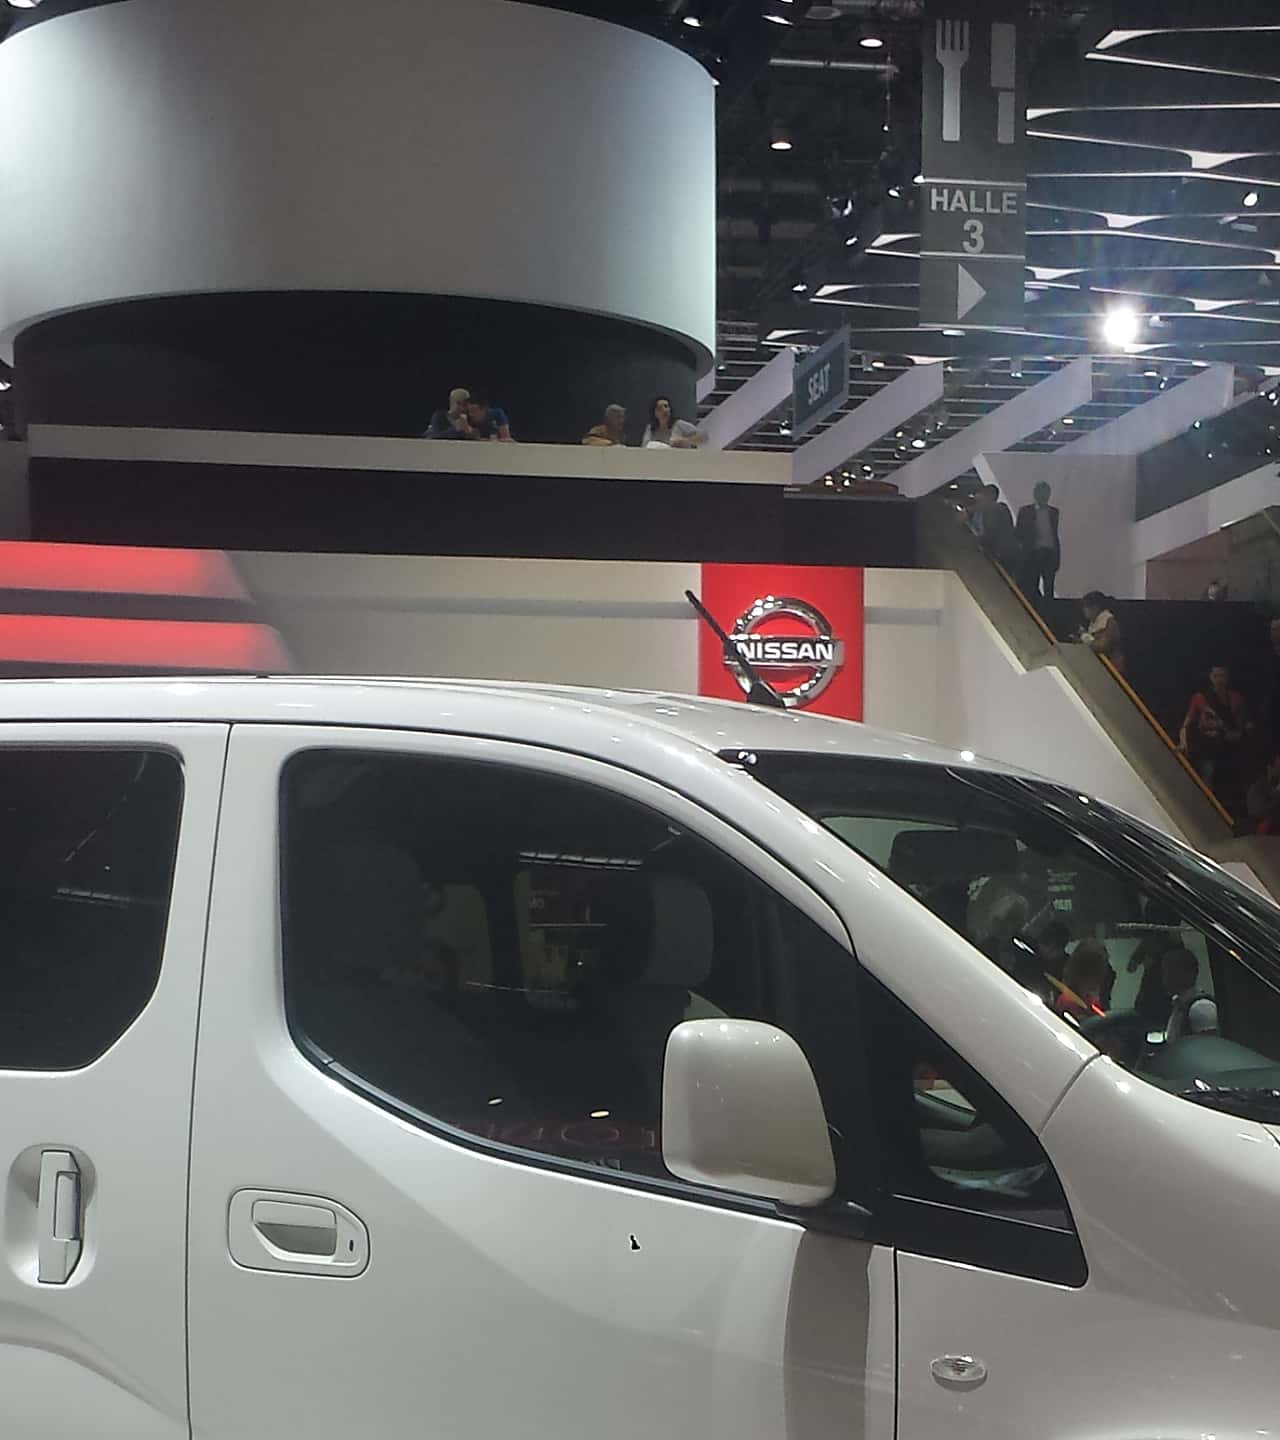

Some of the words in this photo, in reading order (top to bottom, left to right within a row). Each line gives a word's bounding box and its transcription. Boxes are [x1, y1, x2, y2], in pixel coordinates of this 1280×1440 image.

[930, 187, 1018, 215] HALLE
[962, 219, 985, 254] 3
[735, 642, 834, 660] NISSAN
